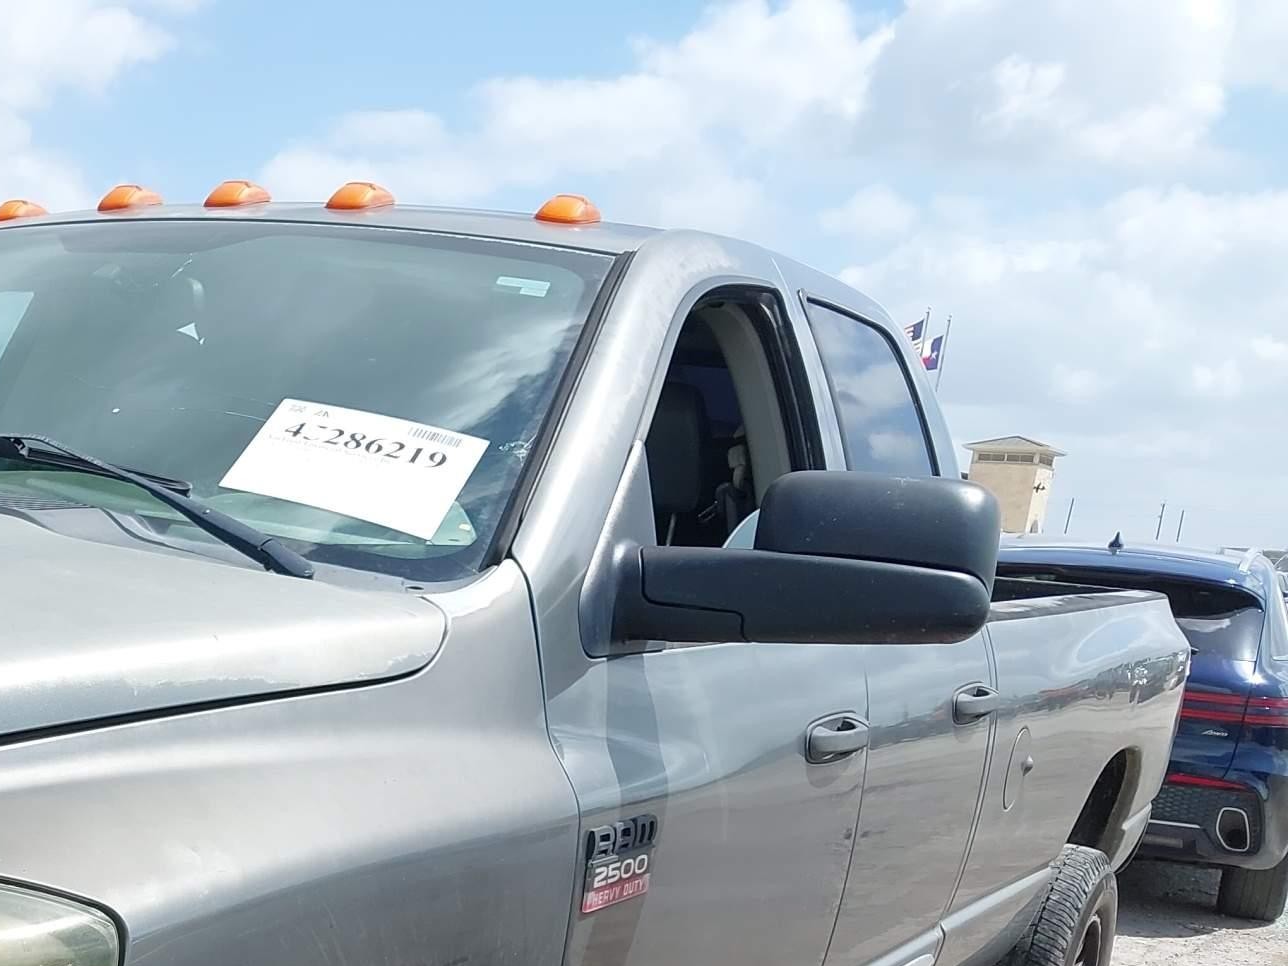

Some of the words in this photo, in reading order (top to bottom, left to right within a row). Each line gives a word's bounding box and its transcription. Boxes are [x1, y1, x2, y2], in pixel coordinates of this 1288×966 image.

[593, 854, 649, 889] 2500
[592, 886, 621, 905] HEAVY
[623, 879, 643, 896] DUTY
